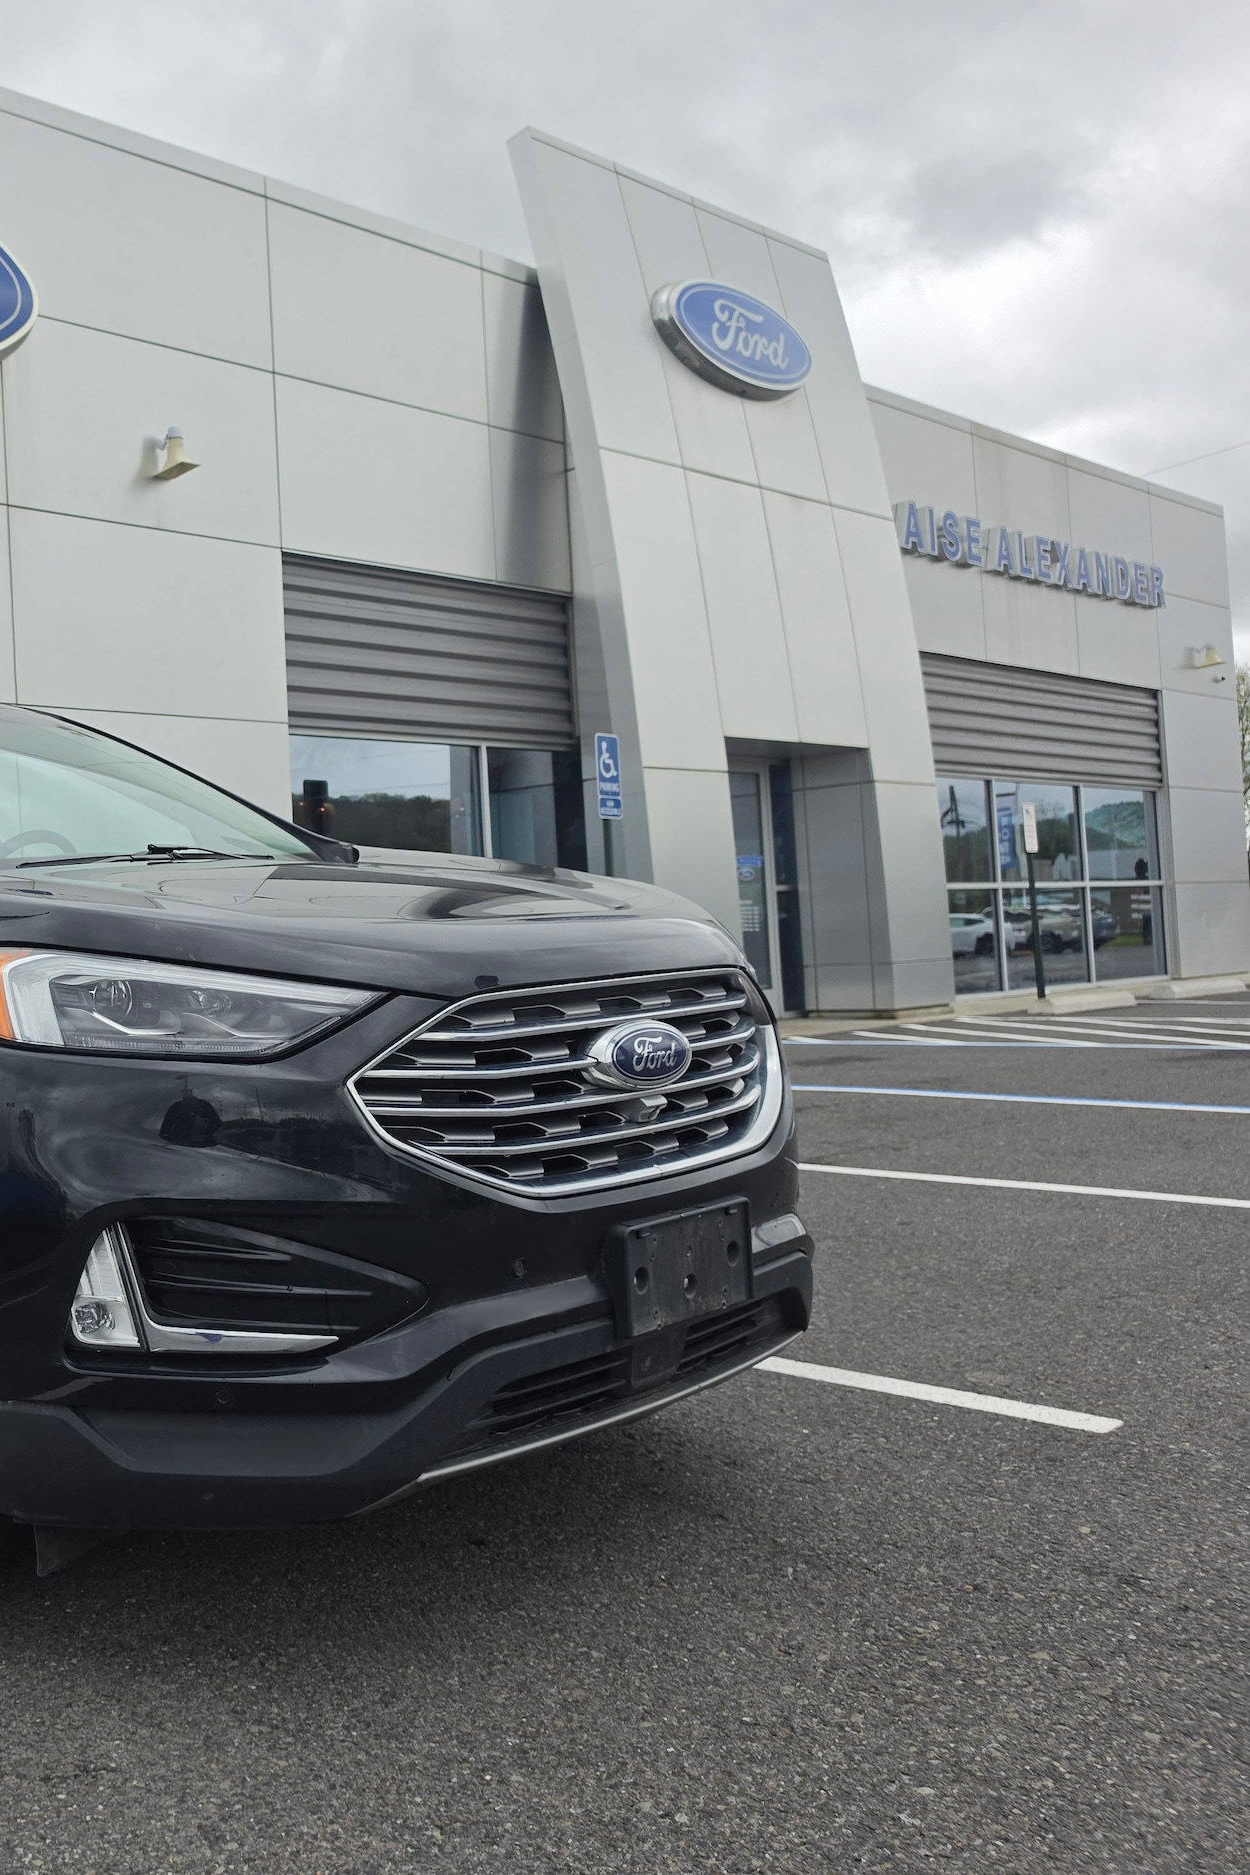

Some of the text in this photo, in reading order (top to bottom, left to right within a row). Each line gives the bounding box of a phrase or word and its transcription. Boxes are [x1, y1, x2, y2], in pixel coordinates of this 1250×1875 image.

[711, 298, 789, 370] Ford
[994, 526, 1167, 609] ALEXANDER
[632, 1035, 678, 1073] Ford
